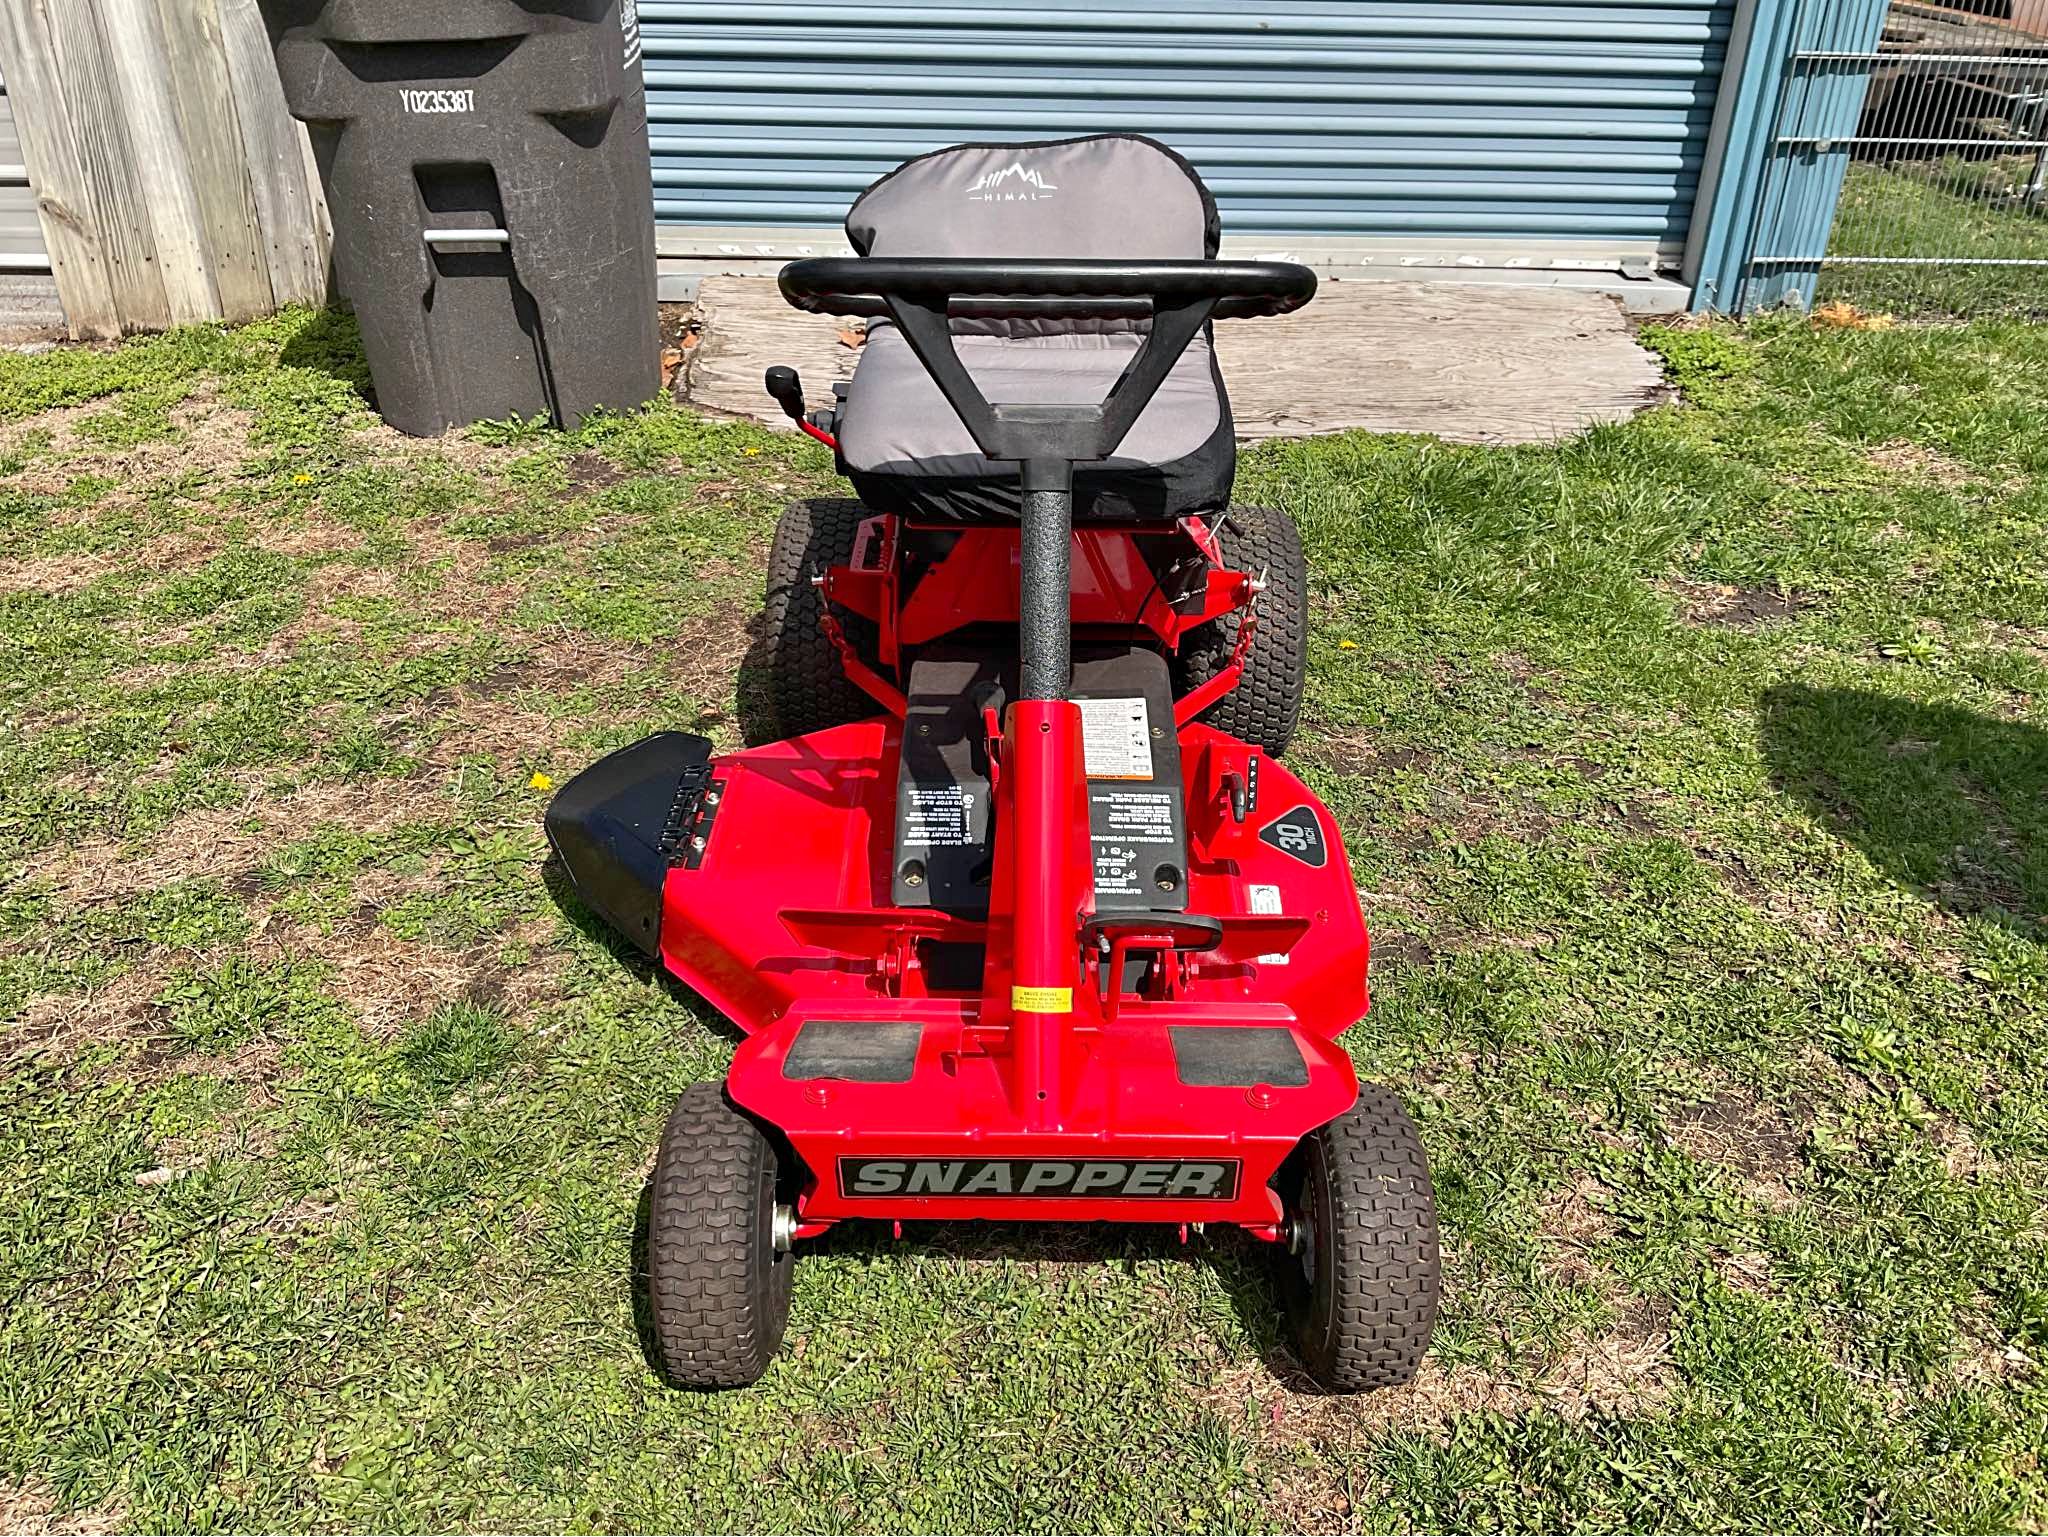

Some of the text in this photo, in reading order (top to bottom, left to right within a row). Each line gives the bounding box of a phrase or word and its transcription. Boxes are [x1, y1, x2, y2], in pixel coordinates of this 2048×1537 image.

[399, 89, 475, 113] Y0235387
[965, 162, 1059, 192] HIMAL
[984, 192, 1037, 201] HIMAL
[1276, 823, 1307, 851] 30
[1303, 827, 1318, 845] INCH
[853, 1161, 1227, 1195] SNAPPER
